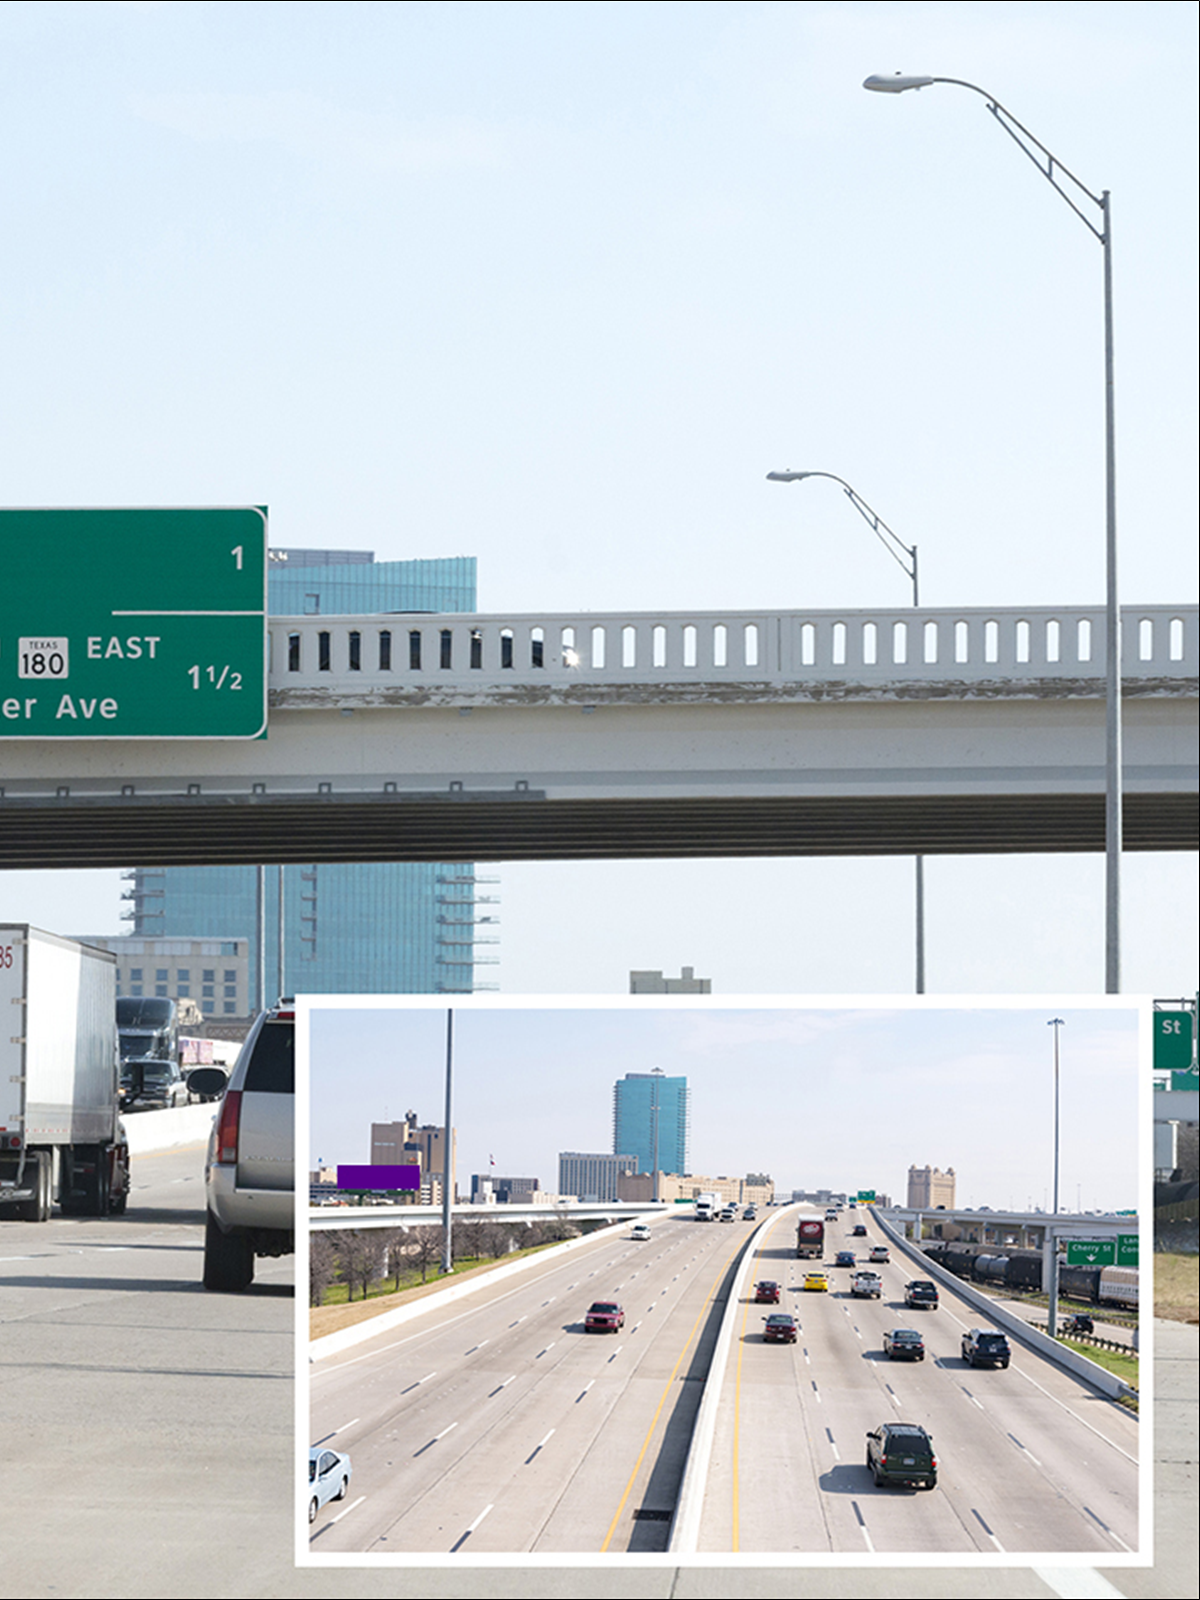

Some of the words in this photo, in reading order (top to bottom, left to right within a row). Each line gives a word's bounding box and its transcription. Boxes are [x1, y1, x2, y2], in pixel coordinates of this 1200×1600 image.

[231, 545, 243, 570] 1
[29, 641, 58, 650] TEXAS
[87, 636, 161, 659] EAST
[22, 653, 64, 675] 180
[55, 694, 118, 719] Ave
[1162, 1019, 1181, 1034] St
[1072, 1244, 1100, 1254] Cherry
[1103, 1244, 1111, 1253] St
